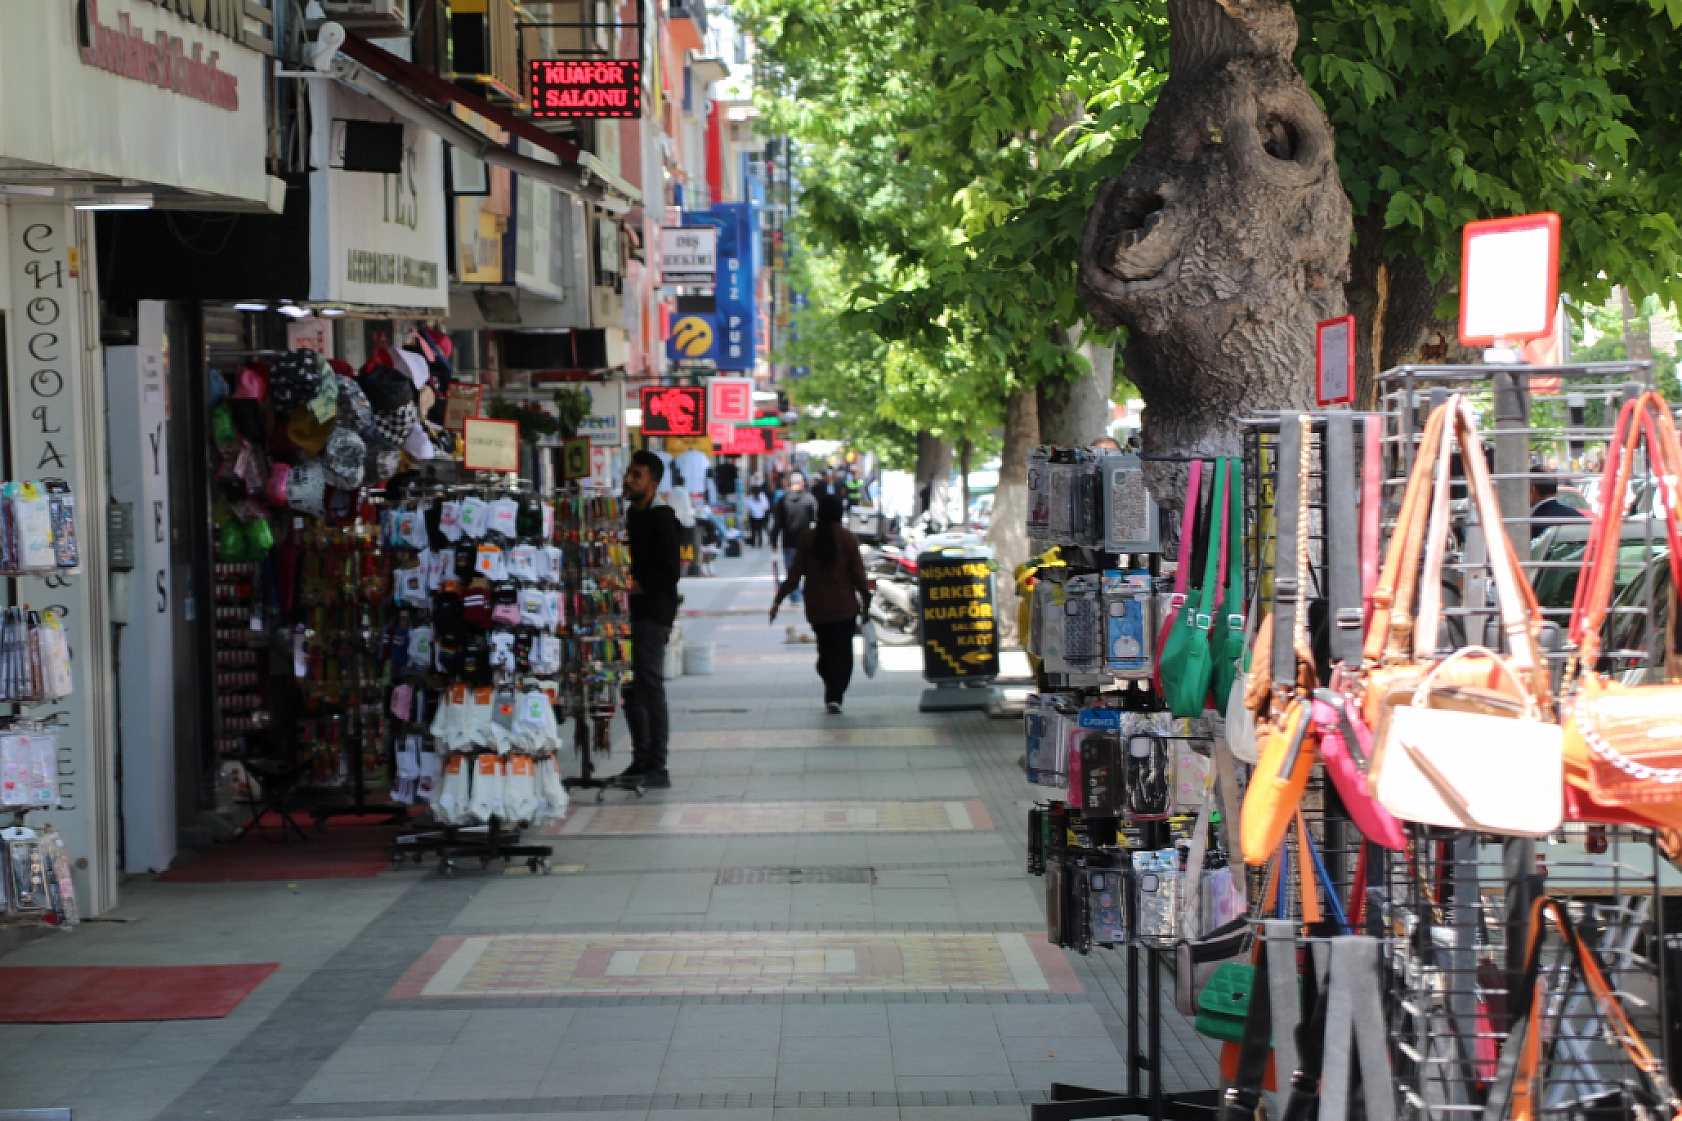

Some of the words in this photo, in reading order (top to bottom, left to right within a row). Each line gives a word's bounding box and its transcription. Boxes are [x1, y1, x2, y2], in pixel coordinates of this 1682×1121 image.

[545, 64, 624, 84] KUAFÖR
[545, 89, 628, 107] SALONU
[929, 583, 987, 600] ERKEK
[924, 601, 993, 620] KUAFÖR
